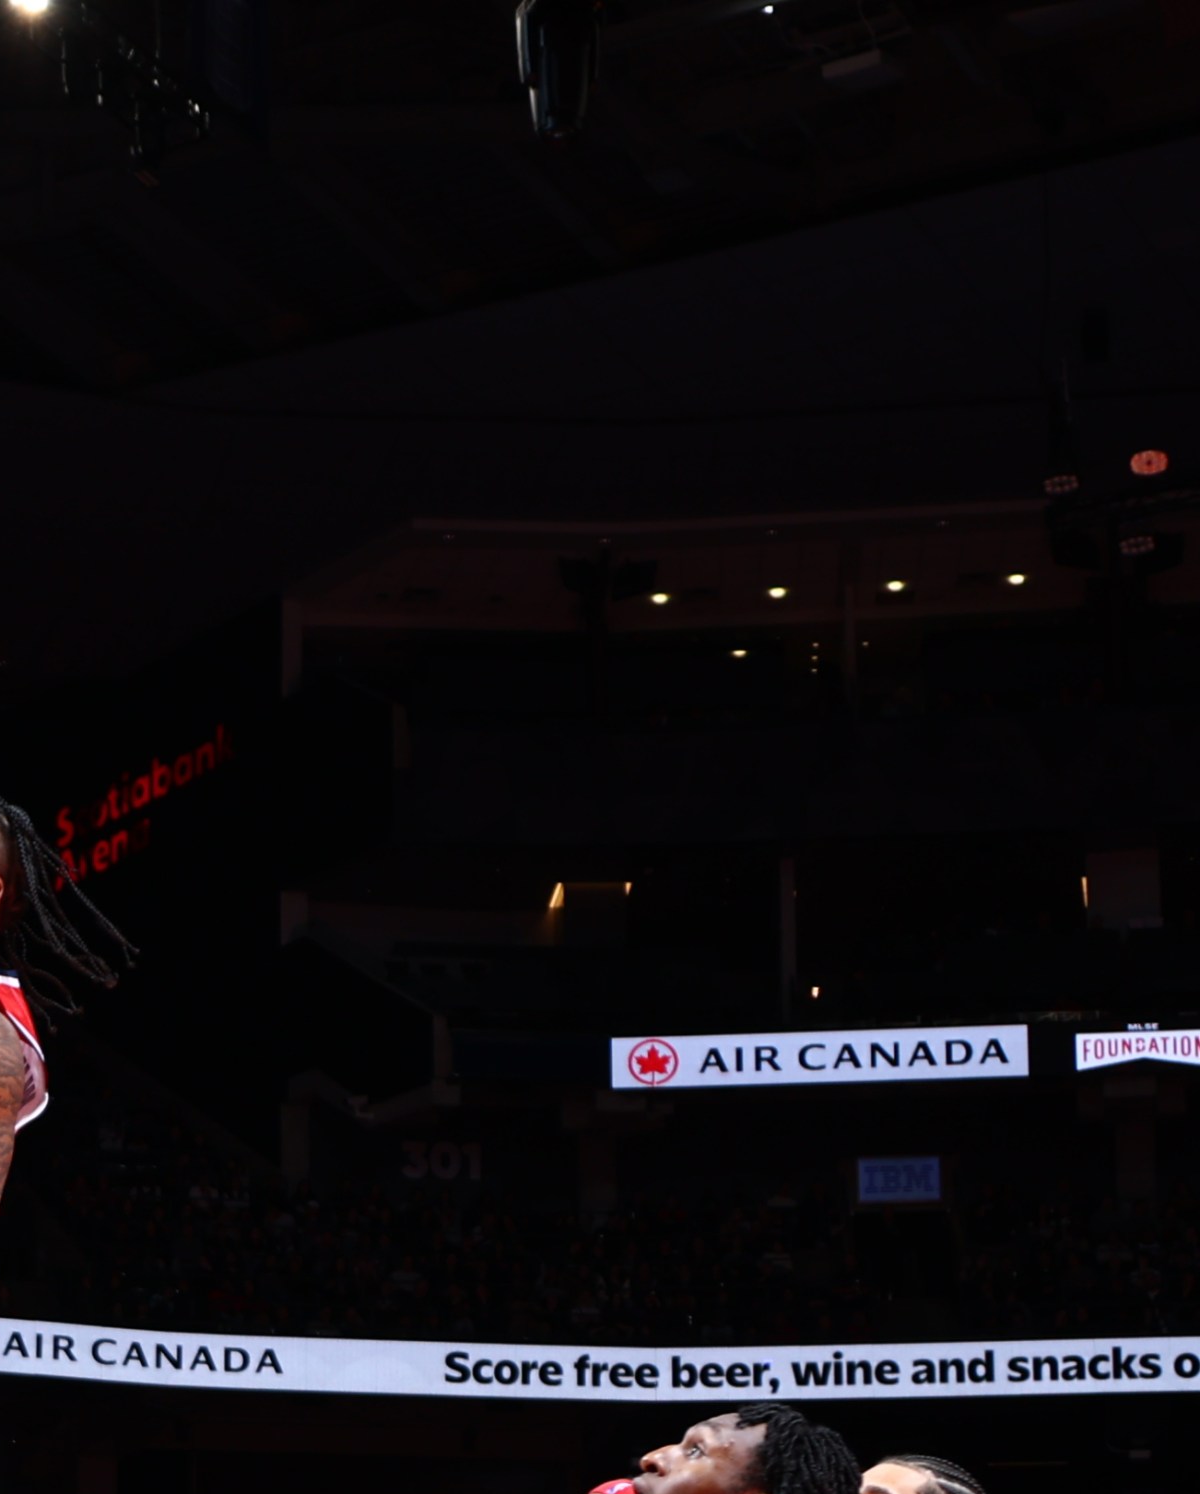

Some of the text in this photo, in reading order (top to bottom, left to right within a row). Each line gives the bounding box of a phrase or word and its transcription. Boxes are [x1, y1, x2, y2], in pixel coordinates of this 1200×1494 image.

[55, 720, 235, 848] Sotiabank
[53, 817, 151, 893] Aren
[699, 1038, 1010, 1074] AIR CANADA
[401, 1140, 482, 1180] 301
[863, 1164, 934, 1194] IBM
[3, 1331, 284, 1374] AIR CANADA
[444, 1346, 1200, 1394] Score free beer, wine and snacks o
